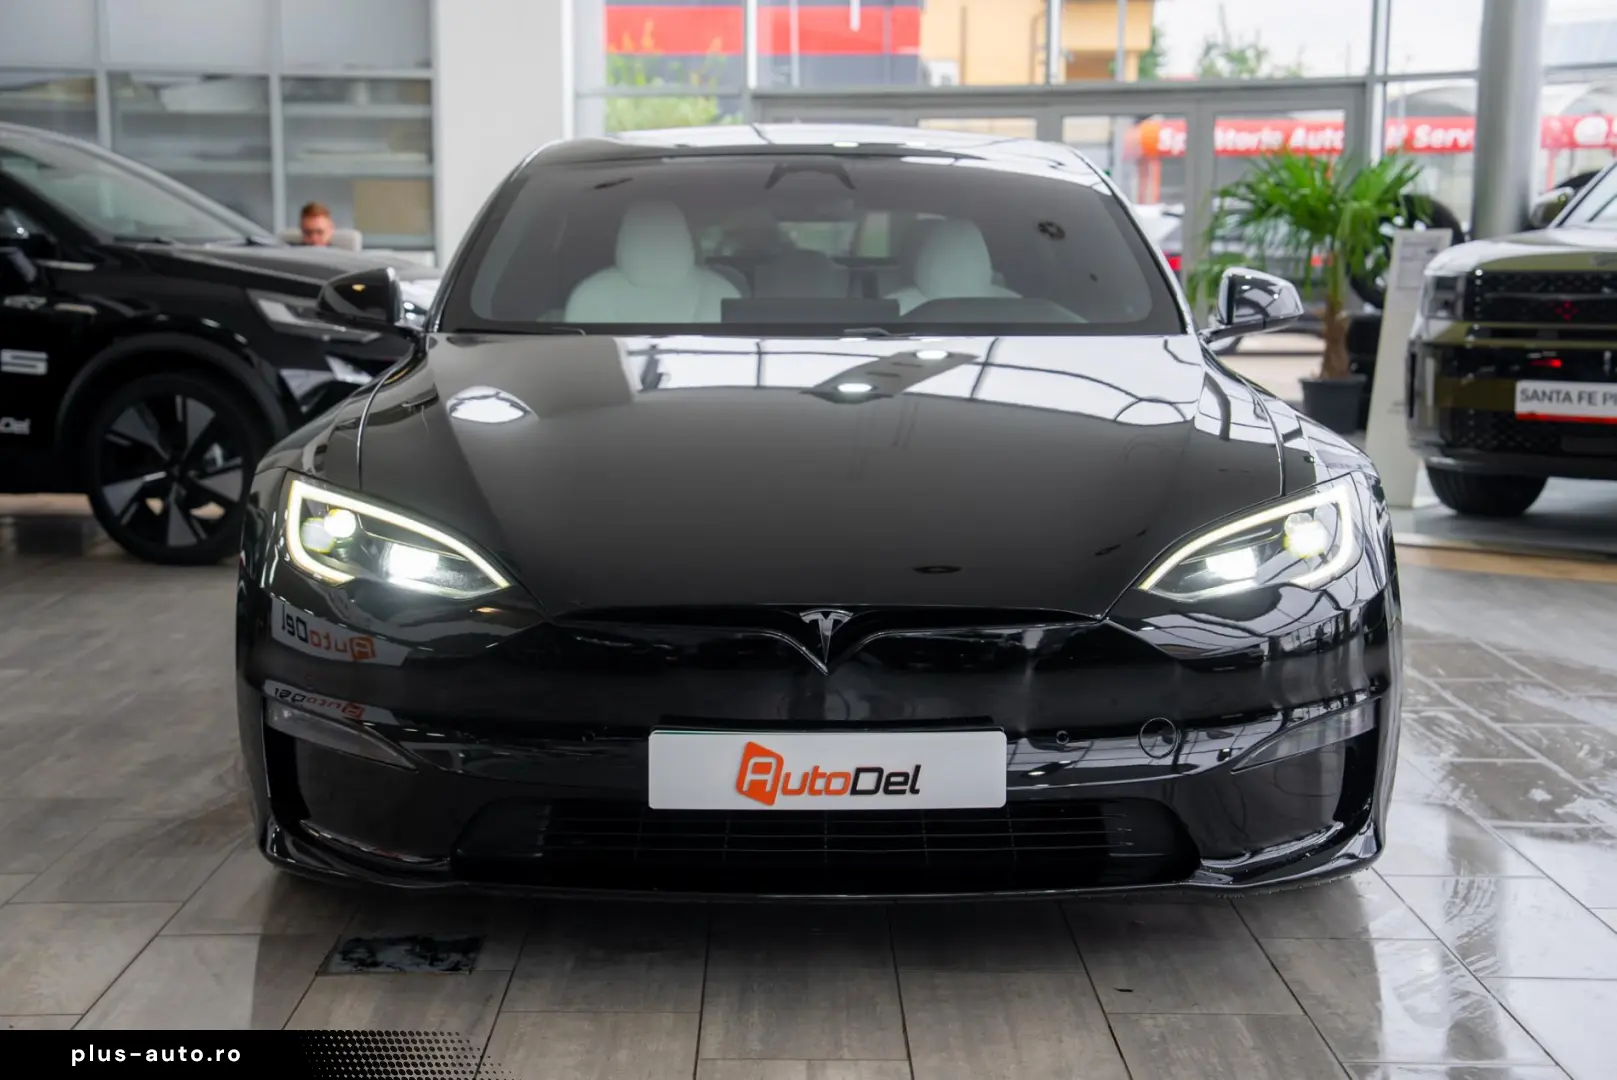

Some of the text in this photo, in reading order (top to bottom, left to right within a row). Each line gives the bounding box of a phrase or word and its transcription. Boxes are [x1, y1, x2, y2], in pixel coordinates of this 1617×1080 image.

[1520, 387, 1573, 405] SANTA
[1577, 390, 1598, 406] FE
[736, 741, 922, 806] AutoDel
